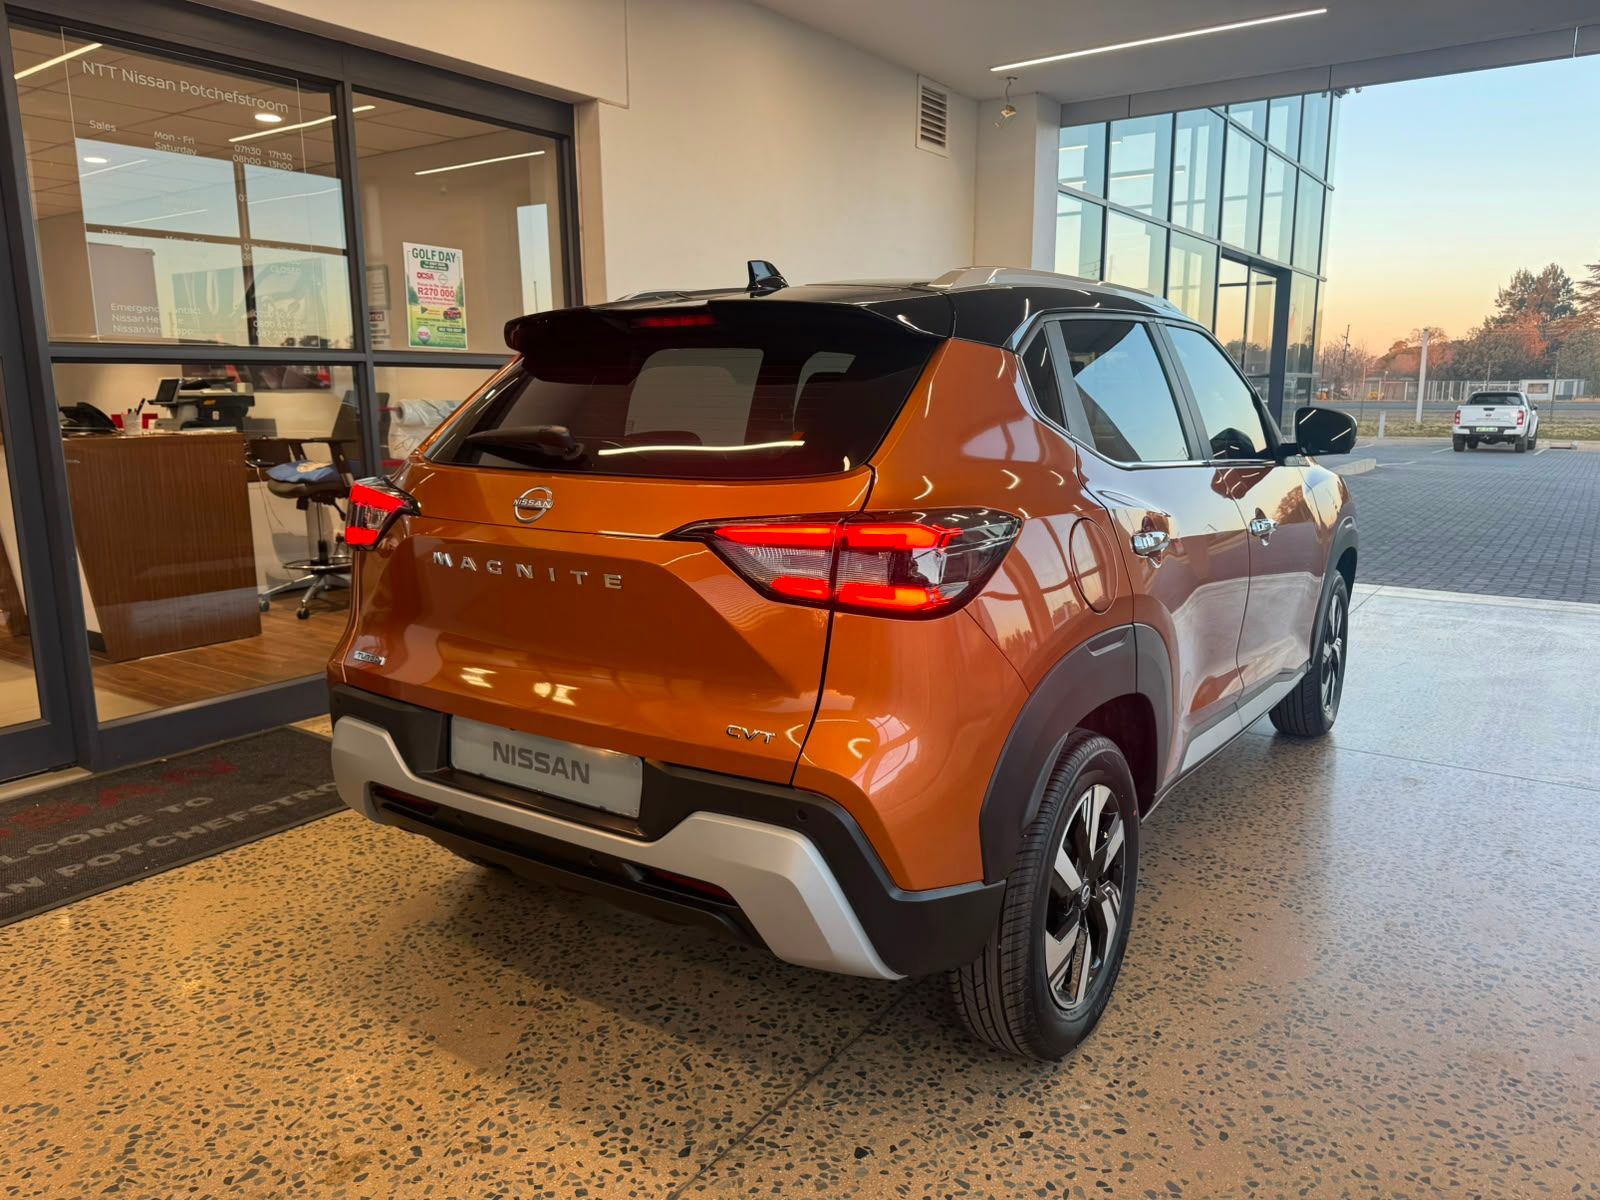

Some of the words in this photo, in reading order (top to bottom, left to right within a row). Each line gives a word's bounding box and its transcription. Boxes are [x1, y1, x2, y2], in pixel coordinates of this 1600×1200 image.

[81, 60, 117, 80] NTT
[122, 68, 176, 92] Nissan
[180, 81, 289, 114] Potchefstroom
[89, 119, 117, 132] Sales
[154, 131, 175, 143] Mon
[183, 134, 195, 145] Fri
[154, 141, 198, 157] Saturday
[412, 247, 437, 260] GOLF
[438, 250, 457, 263] DAY
[417, 287, 438, 297] R270
[440, 289, 455, 298] 000
[111, 303, 160, 313] Emergenc
[112, 314, 145, 323] Nissan
[113, 324, 145, 333] Nissan
[512, 498, 553, 510] NISSAN
[432, 551, 623, 590] MAGNITE
[725, 723, 777, 745] CVT
[492, 740, 590, 785] NISSAN
[158, 796, 215, 815] TO
